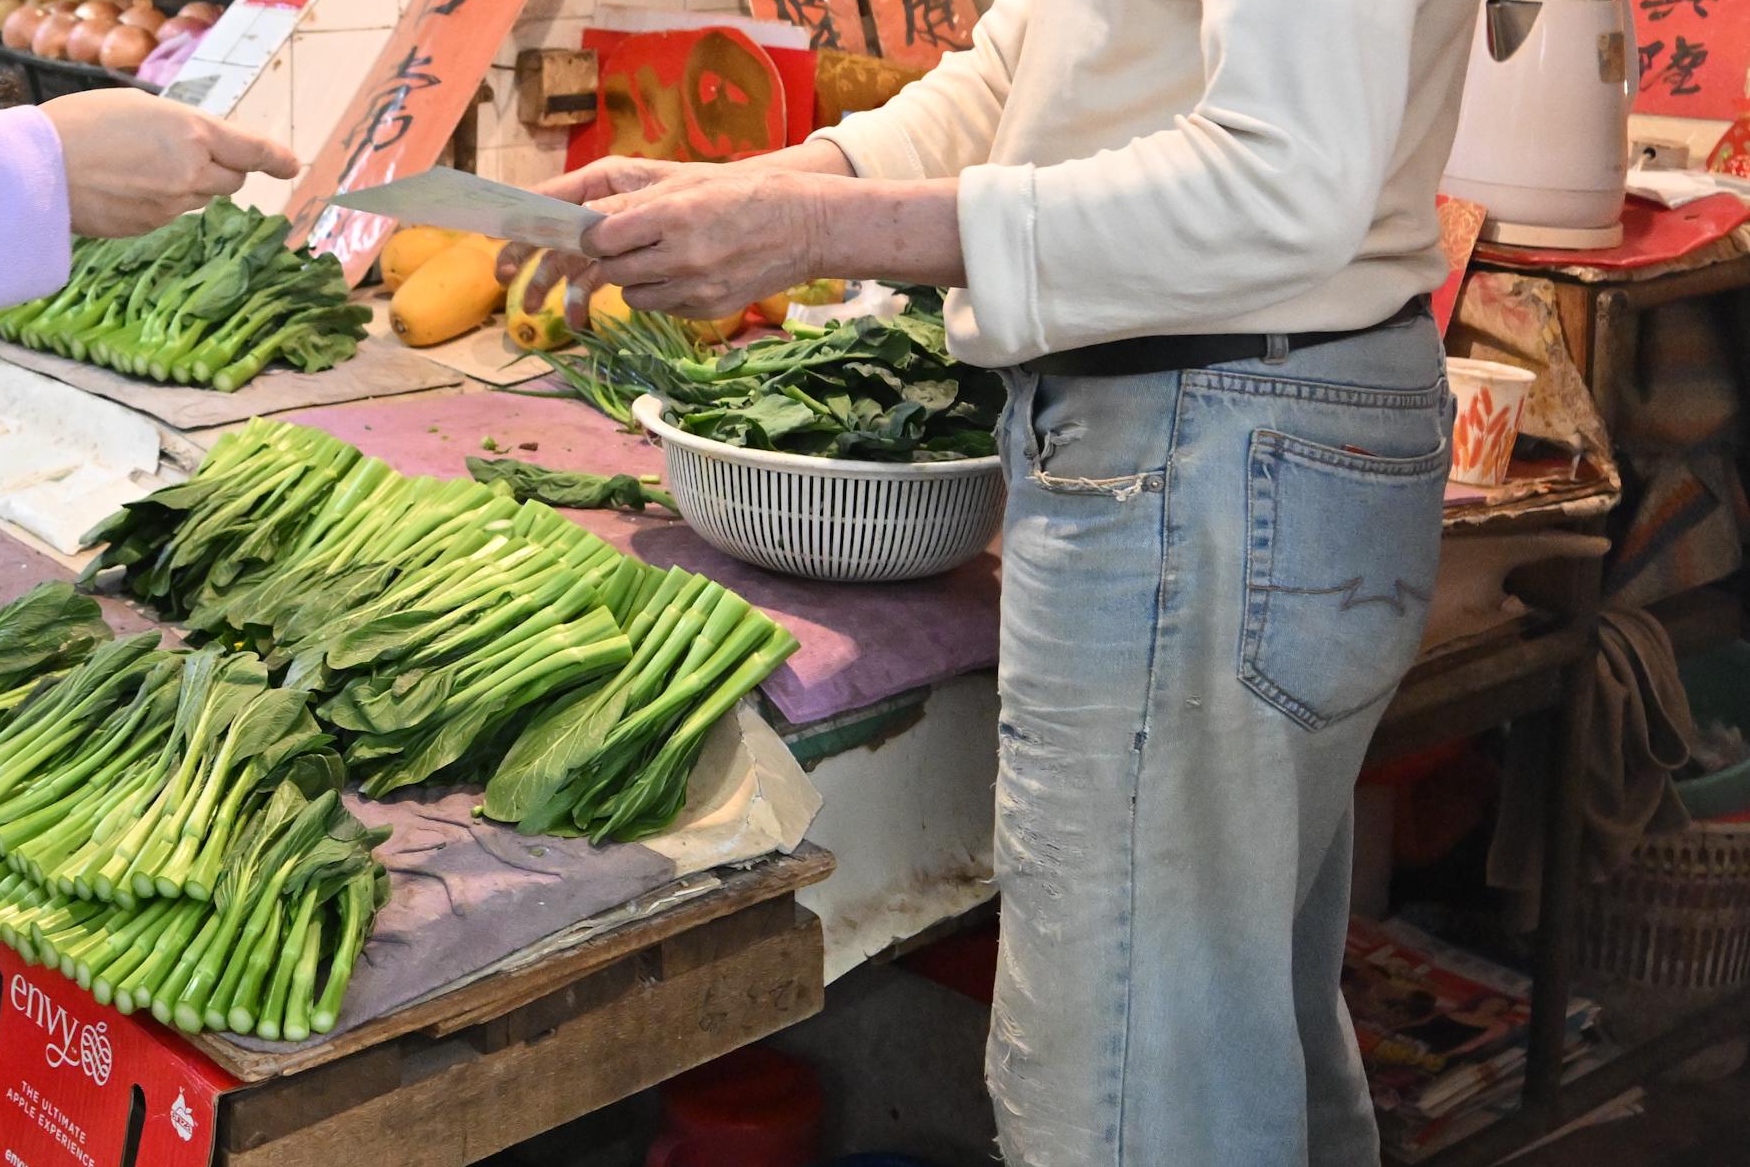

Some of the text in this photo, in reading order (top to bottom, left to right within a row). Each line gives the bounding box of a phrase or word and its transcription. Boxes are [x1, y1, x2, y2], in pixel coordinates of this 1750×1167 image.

[10, 973, 81, 1068] envy
[6, 1087, 36, 1121] APPLE
[37, 1114, 96, 1167] EXPERIENCE
[21, 1080, 86, 1145] THE ULTIMATE
